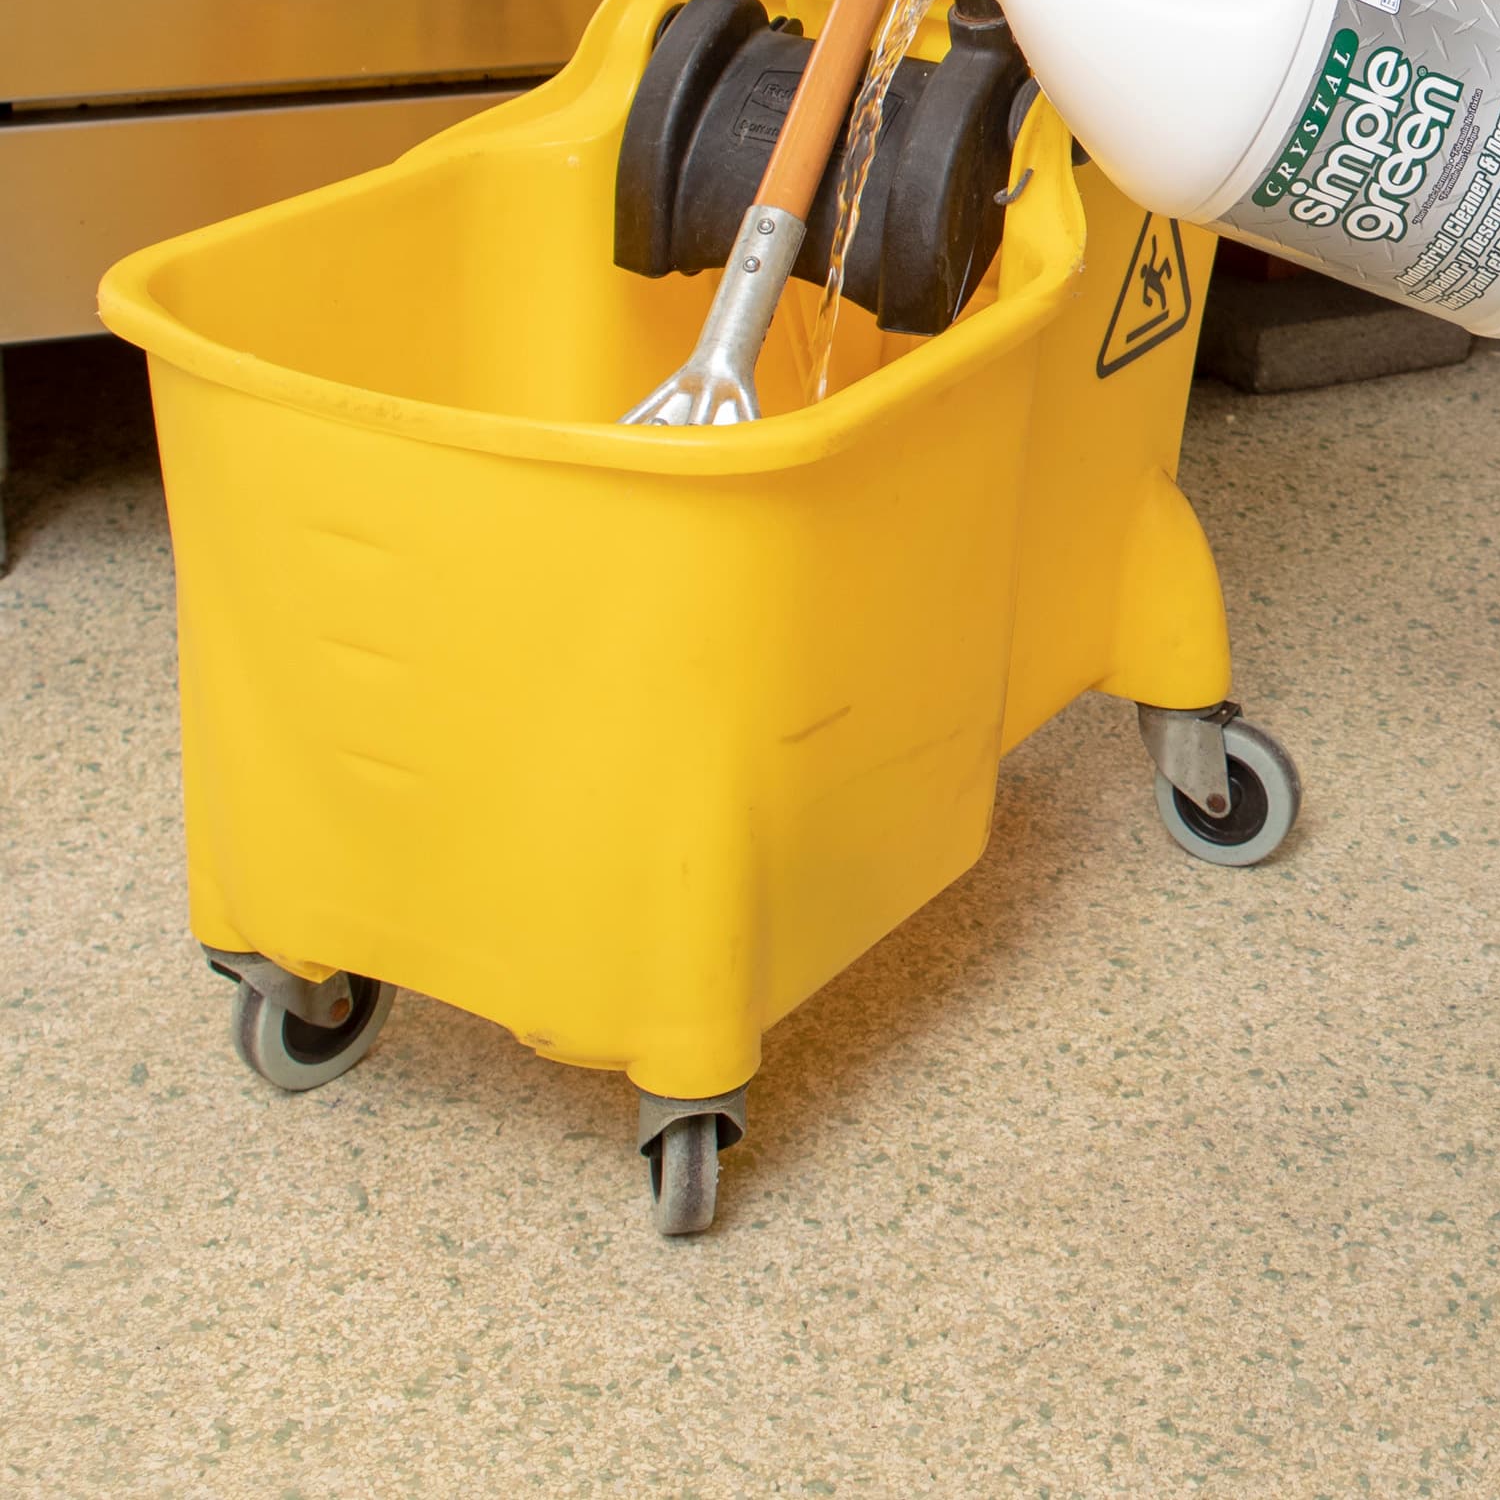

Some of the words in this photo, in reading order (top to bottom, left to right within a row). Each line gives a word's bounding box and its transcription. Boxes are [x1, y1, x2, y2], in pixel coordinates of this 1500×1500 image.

[1266, 49, 1351, 197] CRYSTAL
[1289, 47, 1411, 227] simple
[1395, 231, 1457, 287] Industrial
[1441, 171, 1493, 238] Cleaner
[1407, 261, 1468, 303] Limpiador
[1455, 250, 1478, 269] y
[1436, 266, 1500, 311] Nettoyant
